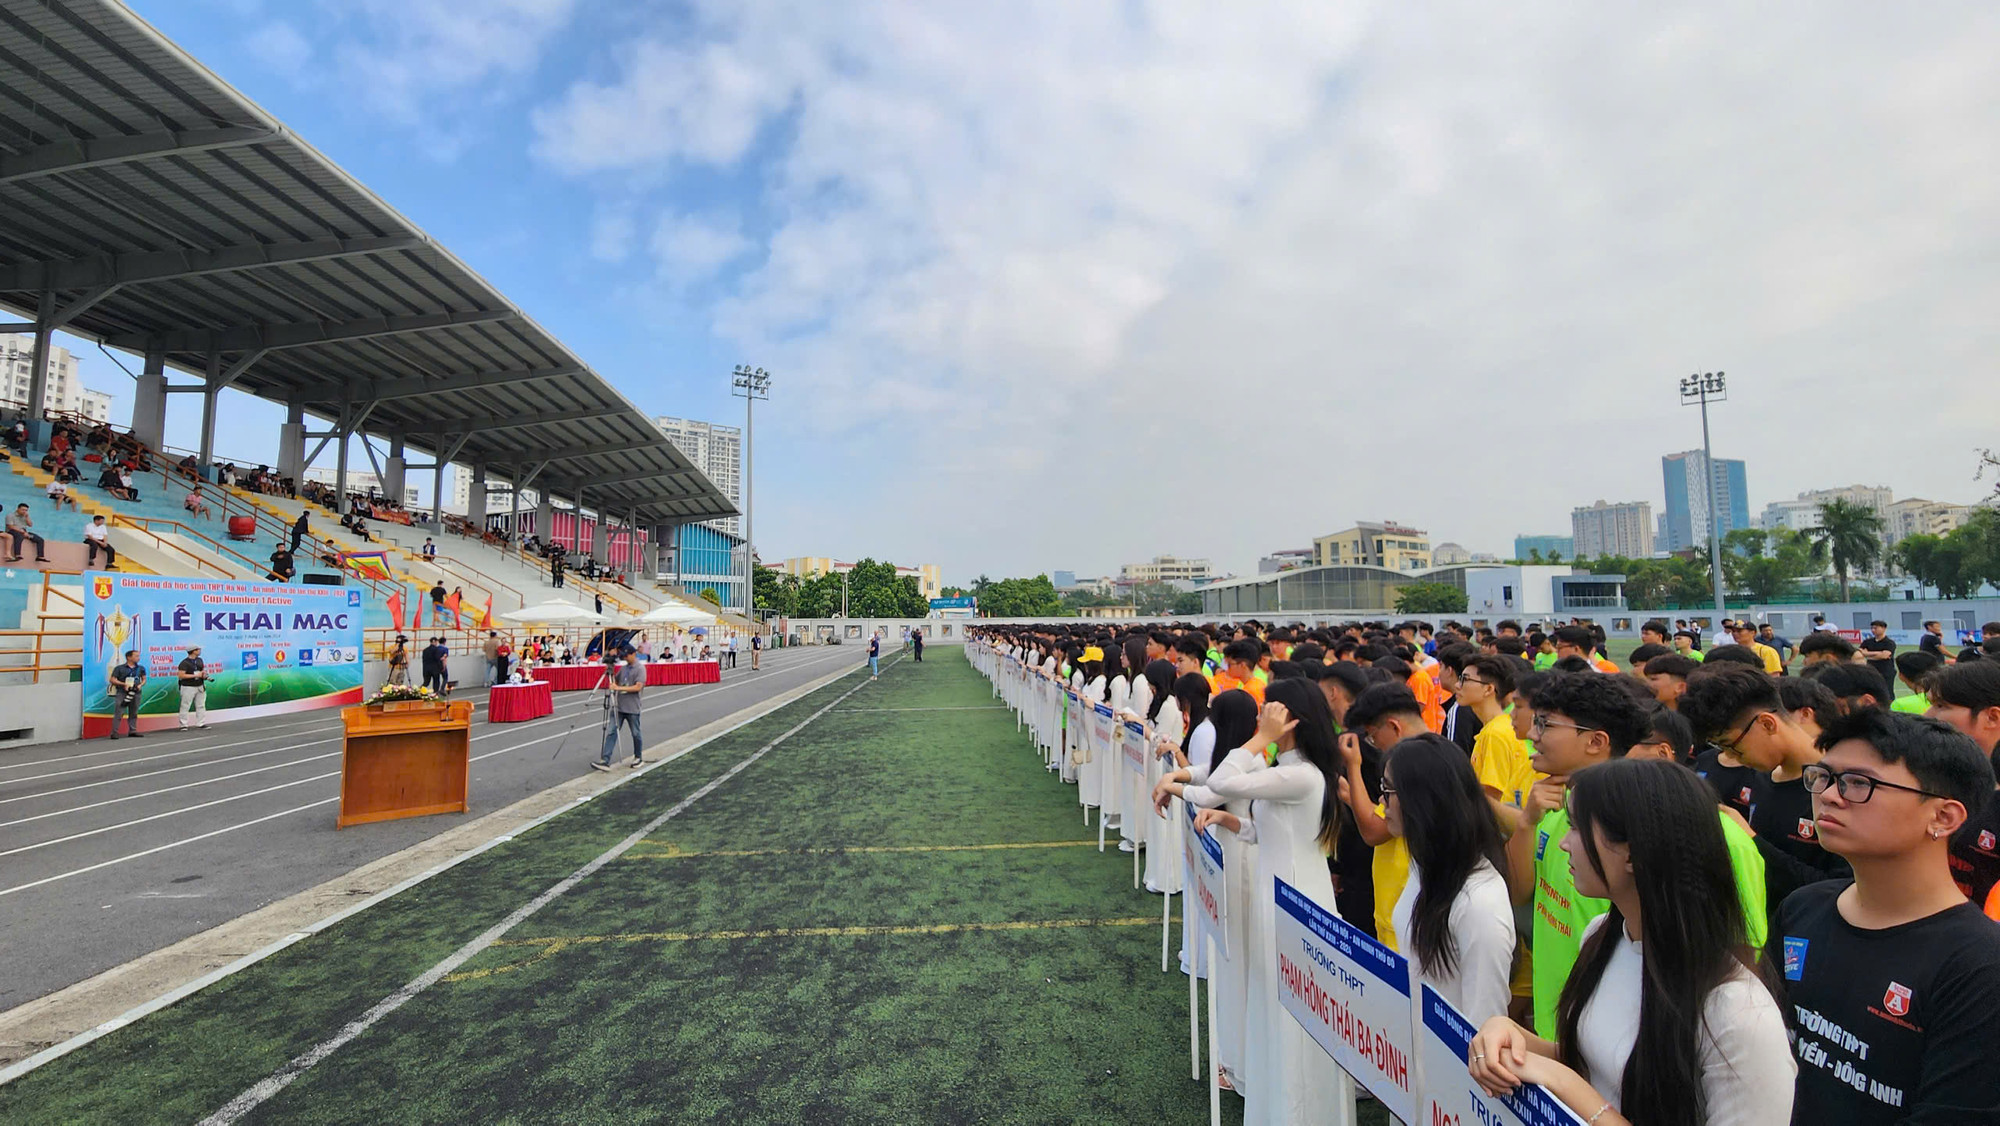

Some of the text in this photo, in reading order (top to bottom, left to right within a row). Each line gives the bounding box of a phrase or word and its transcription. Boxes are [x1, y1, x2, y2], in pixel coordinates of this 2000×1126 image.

[140, 580, 160, 590] bóng
[174, 581, 188, 591] học
[190, 582, 206, 591] sinh
[207, 583, 224, 592] THPT
[203, 594, 221, 604] Cúp
[224, 595, 260, 604] Number
[267, 596, 292, 606] Active
[153, 604, 348, 633] LỄ KHAI MẠC
[1322, 914, 1333, 927] THPT
[1352, 934, 1361, 947] AN
[1375, 948, 1387, 964] THỦ
[1339, 940, 1352, 956] 2024
[1302, 938, 1365, 997] TRƯỜNG THPT
[1887, 994, 1904, 1013] A
[1280, 953, 1409, 1093] PHẠM HỒNG THÁI BA ĐÌNH
[1434, 1002, 1446, 1022] GIẢI
[1447, 1012, 1464, 1039] BÓNG
[1527, 1088, 1539, 1110] HÀ
[1540, 1100, 1556, 1126] NỘI
[1869, 1079, 1903, 1108] ANH
[1513, 1095, 1532, 1125] XXIII
